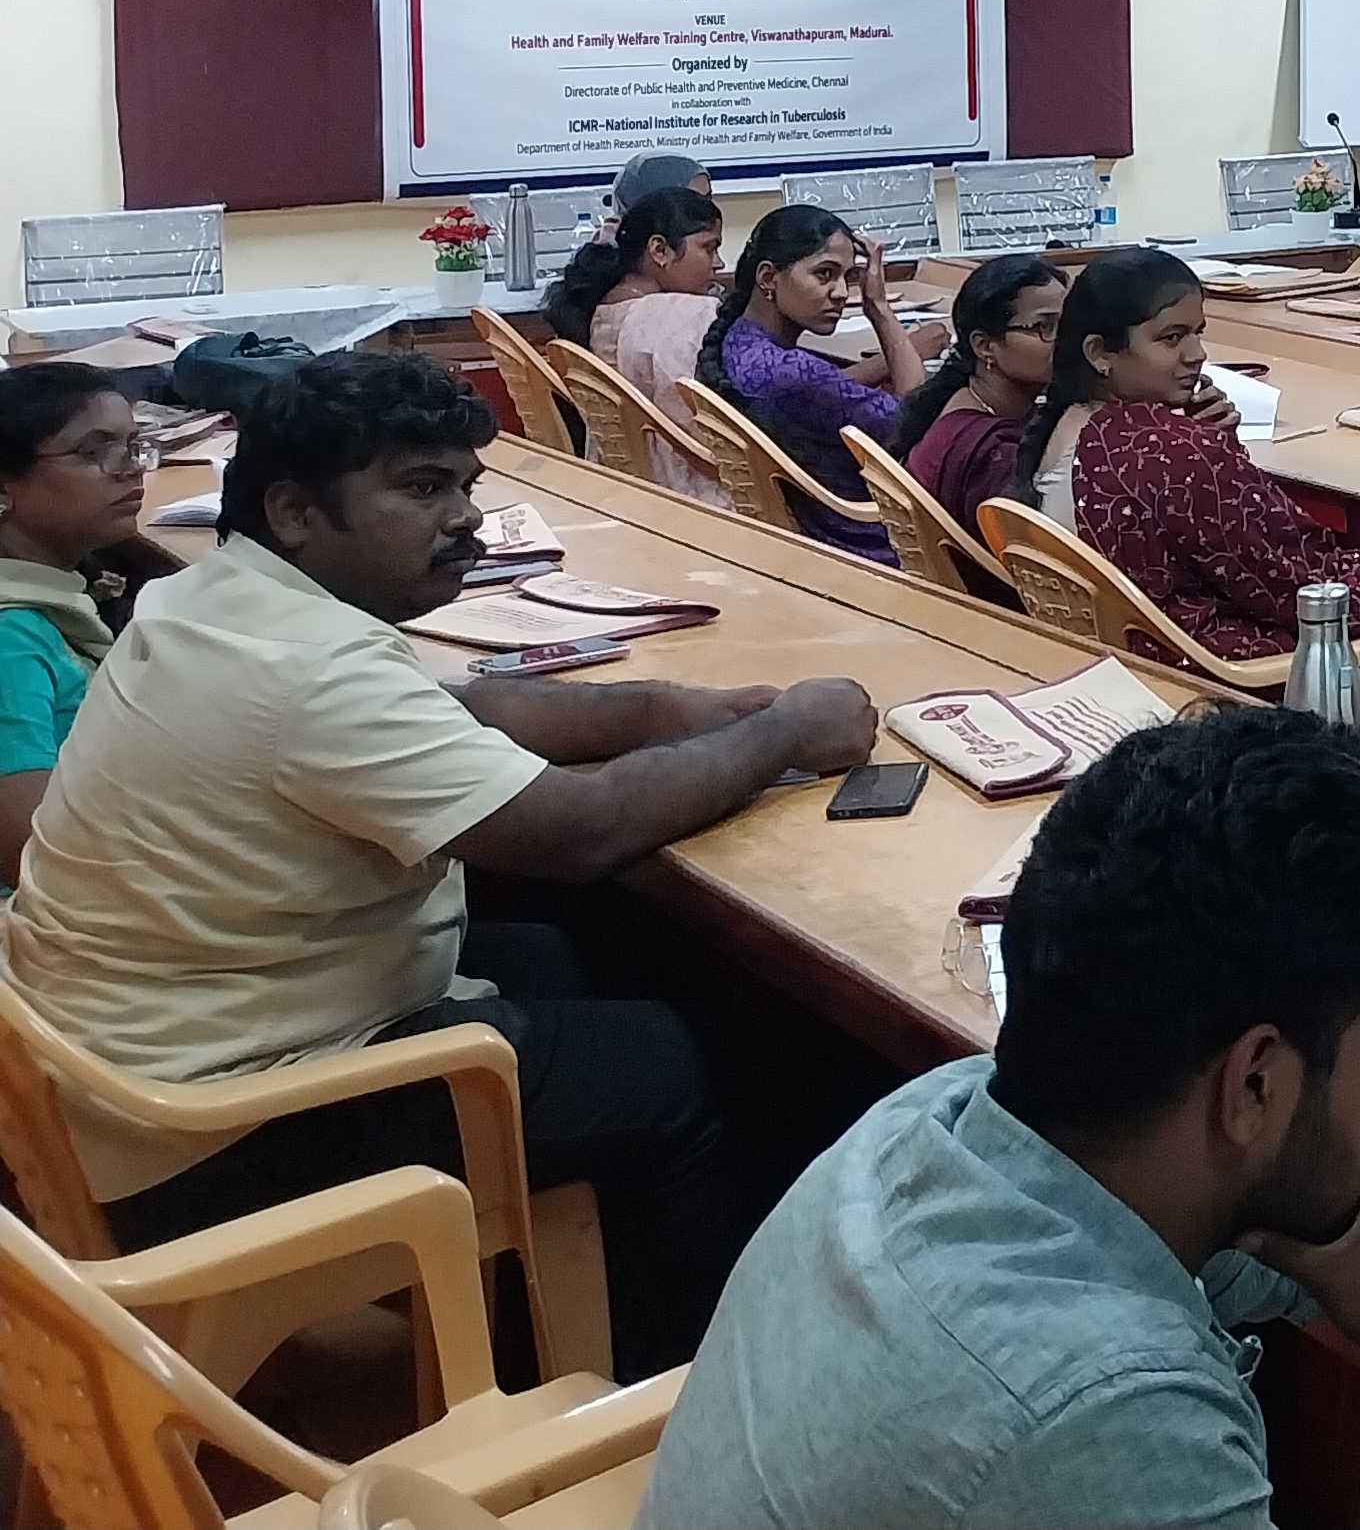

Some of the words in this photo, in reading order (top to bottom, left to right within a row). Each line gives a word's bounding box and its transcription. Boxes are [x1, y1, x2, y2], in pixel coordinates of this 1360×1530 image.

[695, 15, 725, 25] VENUE
[512, 35, 549, 49] Health
[553, 35, 574, 48] and
[577, 34, 614, 49] Family
[617, 33, 660, 46] Welfare
[663, 30, 706, 46] Training
[710, 31, 748, 44] Centre,
[751, 28, 847, 43] Viswanathapuram,
[672, 56, 730, 74] Organized
[734, 55, 748, 73] by
[565, 85, 619, 97] Directorate
[622, 83, 632, 95] of
[634, 83, 663, 95] Public
[665, 81, 695, 93] Health
[697, 81, 715, 92] and
[717, 79, 765, 91] Preventive
[768, 78, 810, 90] Medicine,
[681, 98, 733, 109] collaboration
[734, 97, 751, 107] with
[655, 114, 701, 129] Institute
[703, 112, 718, 126] for
[721, 111, 768, 126] Research
[770, 110, 779, 124] in
[782, 107, 846, 123] Tuberculosis
[517, 144, 570, 156] Department
[572, 141, 582, 152] of
[583, 139, 612, 151] Health
[614, 138, 655, 149] Research,
[657, 136, 690, 149] Ministry
[692, 134, 701, 145] of
[703, 133, 729, 144] Health
[732, 132, 747, 143] and
[749, 130, 775, 144] Family
[813, 127, 861, 139] Government
[863, 125, 872, 136] of
